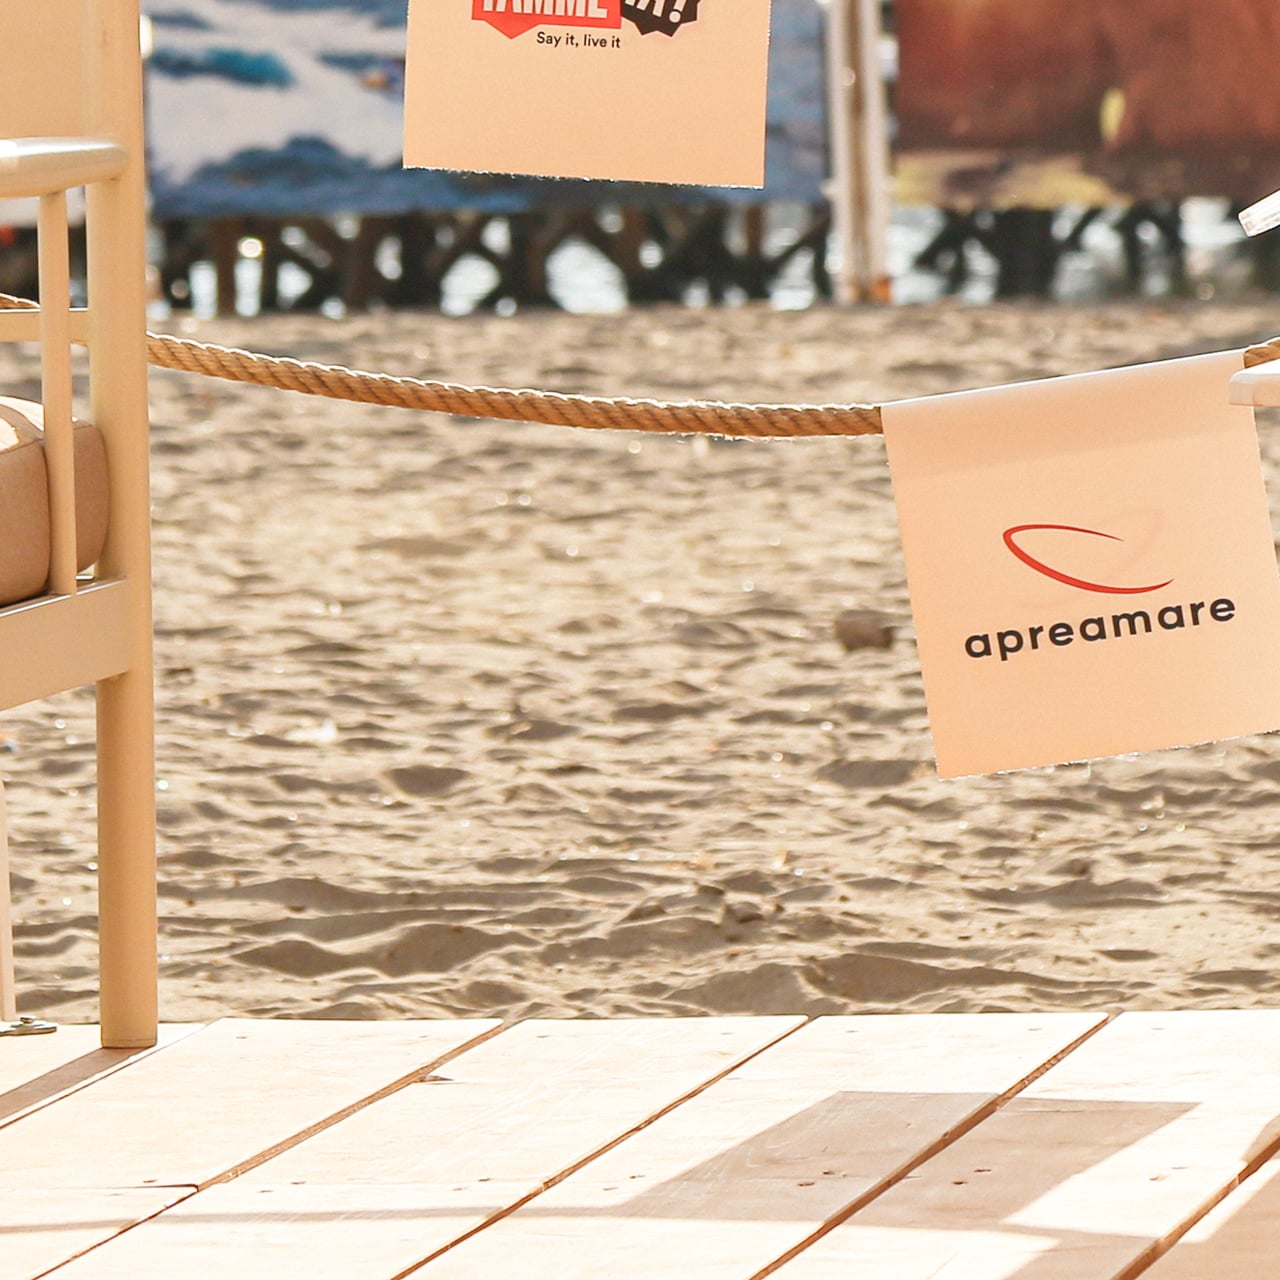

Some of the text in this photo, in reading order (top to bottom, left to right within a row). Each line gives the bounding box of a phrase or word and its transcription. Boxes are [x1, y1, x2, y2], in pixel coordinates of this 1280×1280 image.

[536, 31, 621, 49] Say it, live it
[963, 597, 1237, 662] apreamare
